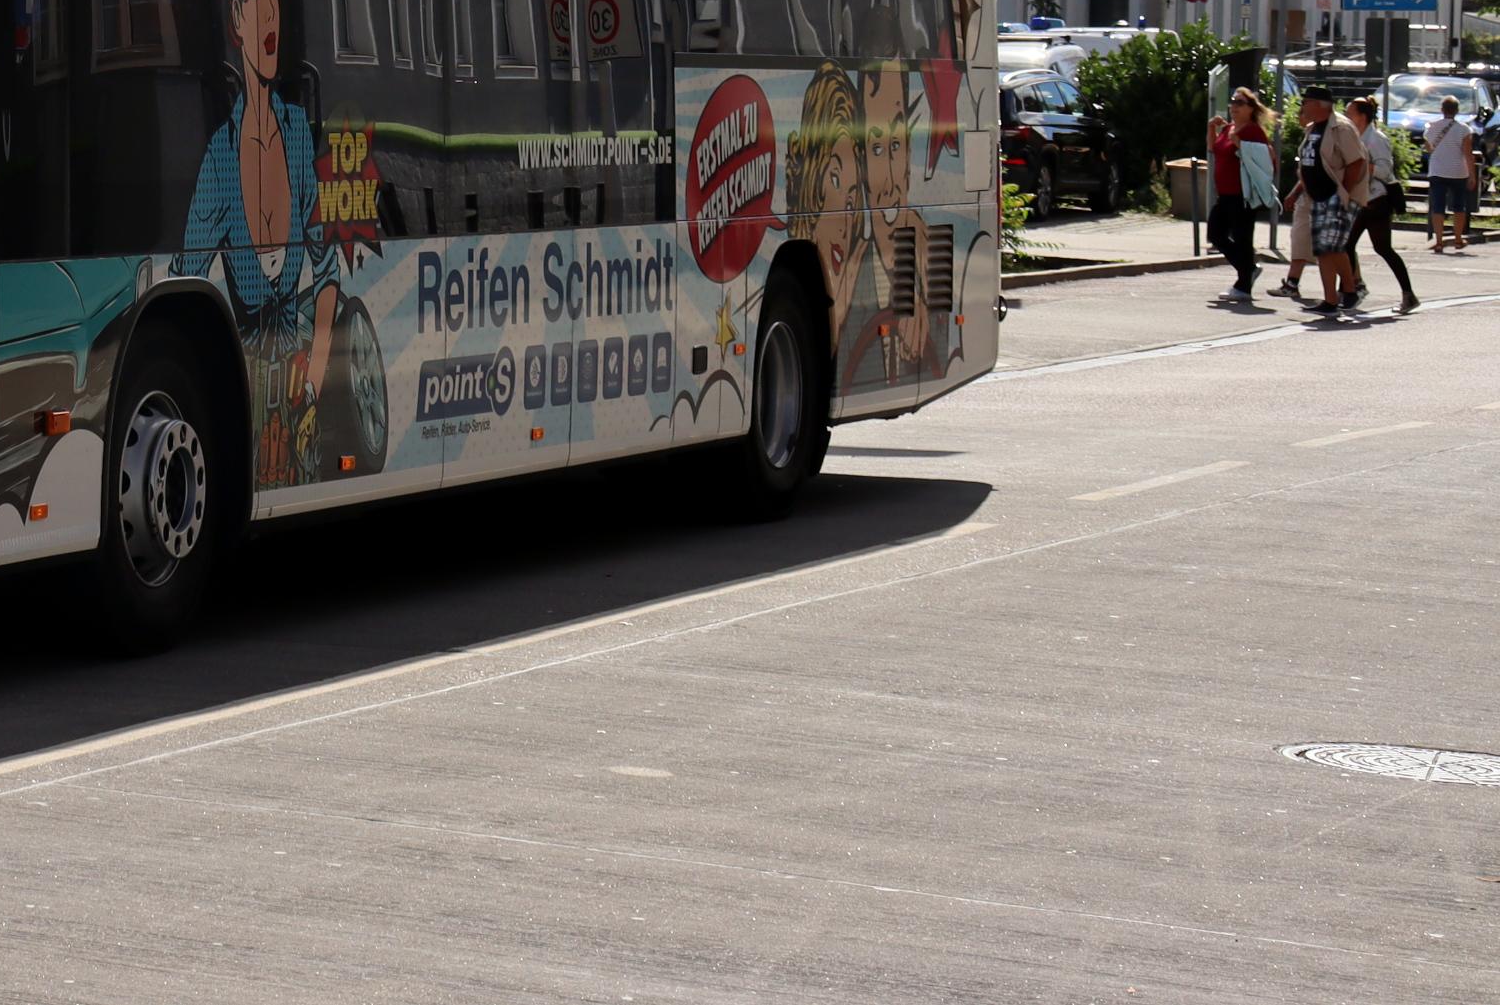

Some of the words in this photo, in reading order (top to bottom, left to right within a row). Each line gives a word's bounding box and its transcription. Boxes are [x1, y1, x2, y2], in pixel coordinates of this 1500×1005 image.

[328, 132, 368, 174] TOP
[696, 108, 743, 188] ERSTMAL
[743, 101, 758, 146] ZU
[318, 179, 378, 222] WORK
[696, 180, 730, 254] REIFEN
[729, 152, 771, 214] SCHMIDT
[418, 247, 530, 333] Reifen
[543, 238, 673, 323] Schmidt
[424, 363, 485, 414] point
